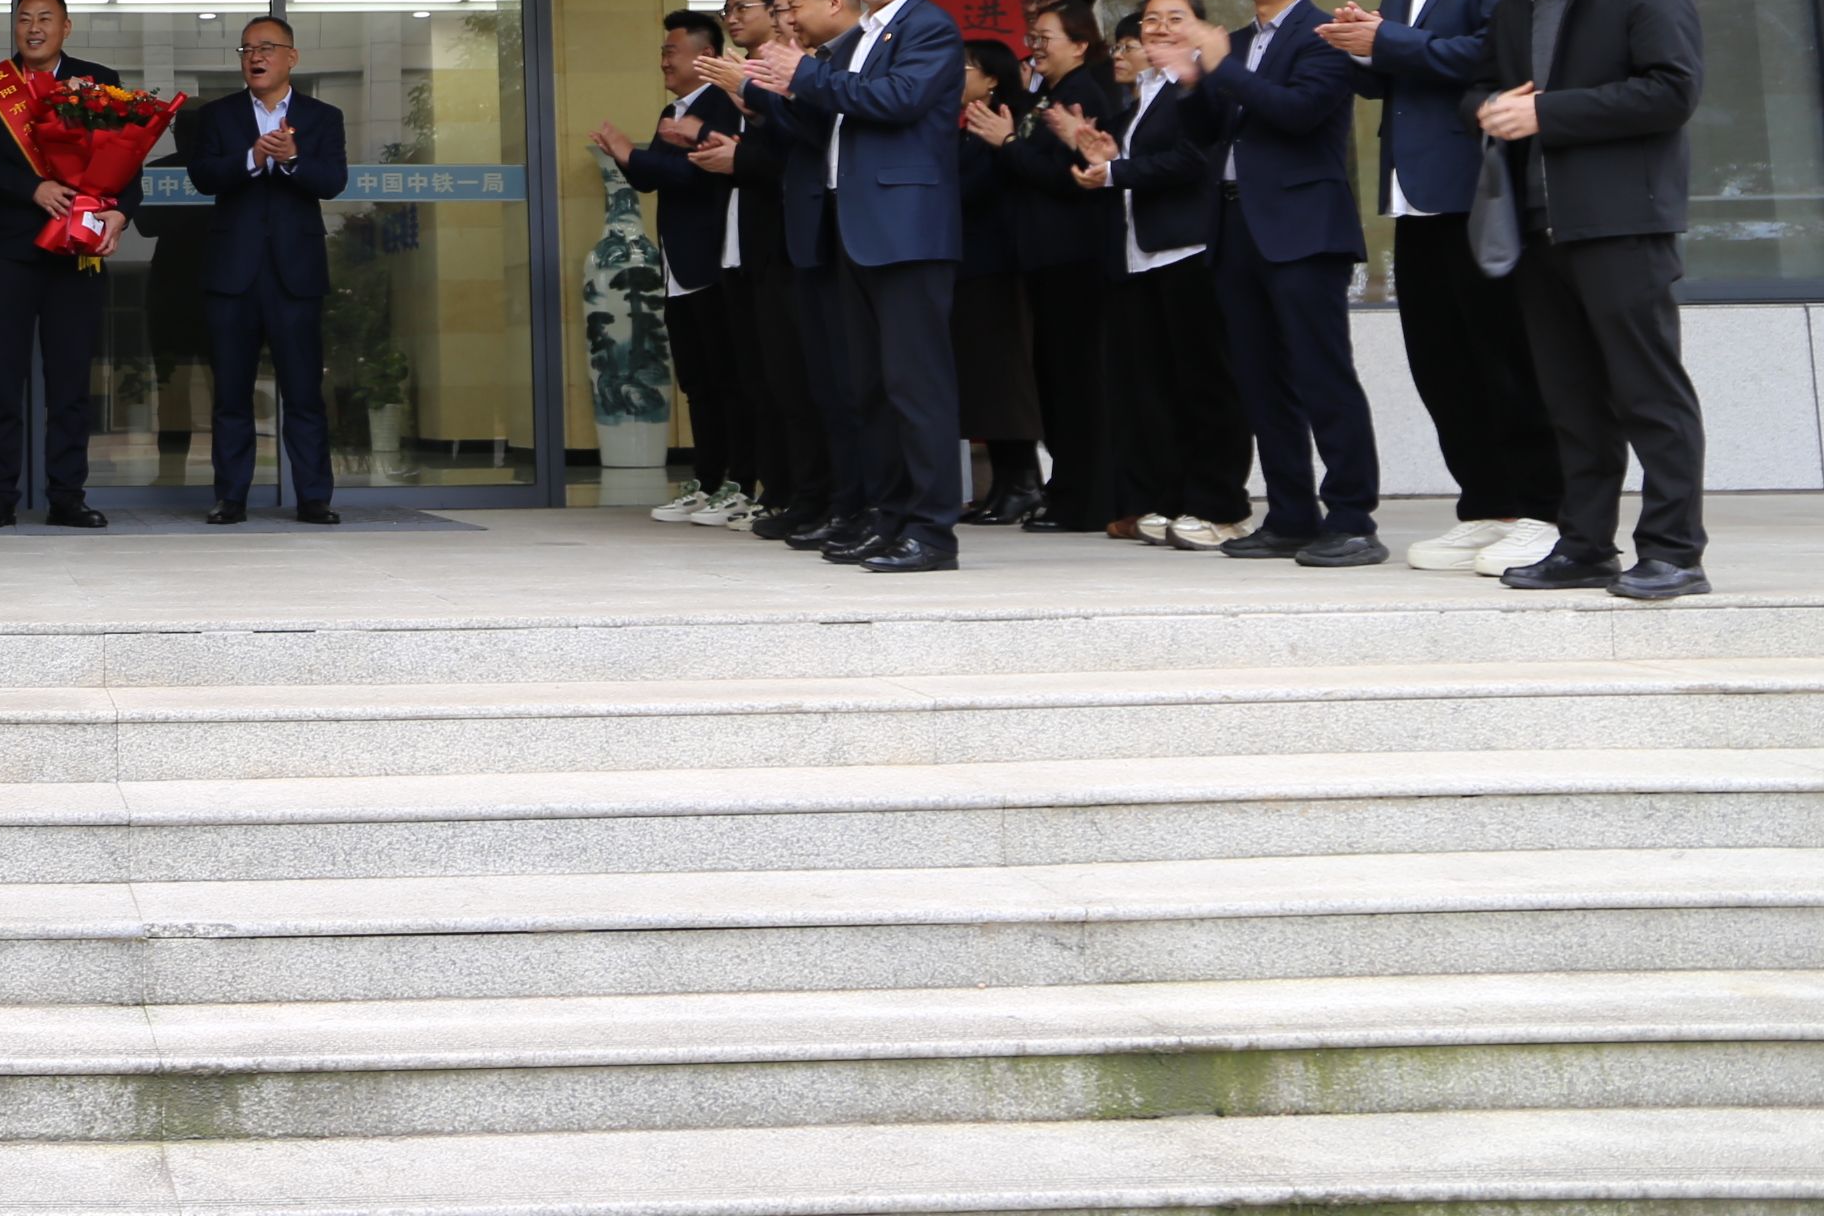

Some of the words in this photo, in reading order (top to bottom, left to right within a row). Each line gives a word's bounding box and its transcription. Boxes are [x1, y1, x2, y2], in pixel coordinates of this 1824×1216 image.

[357, 173, 504, 193] 中国中铁一局
